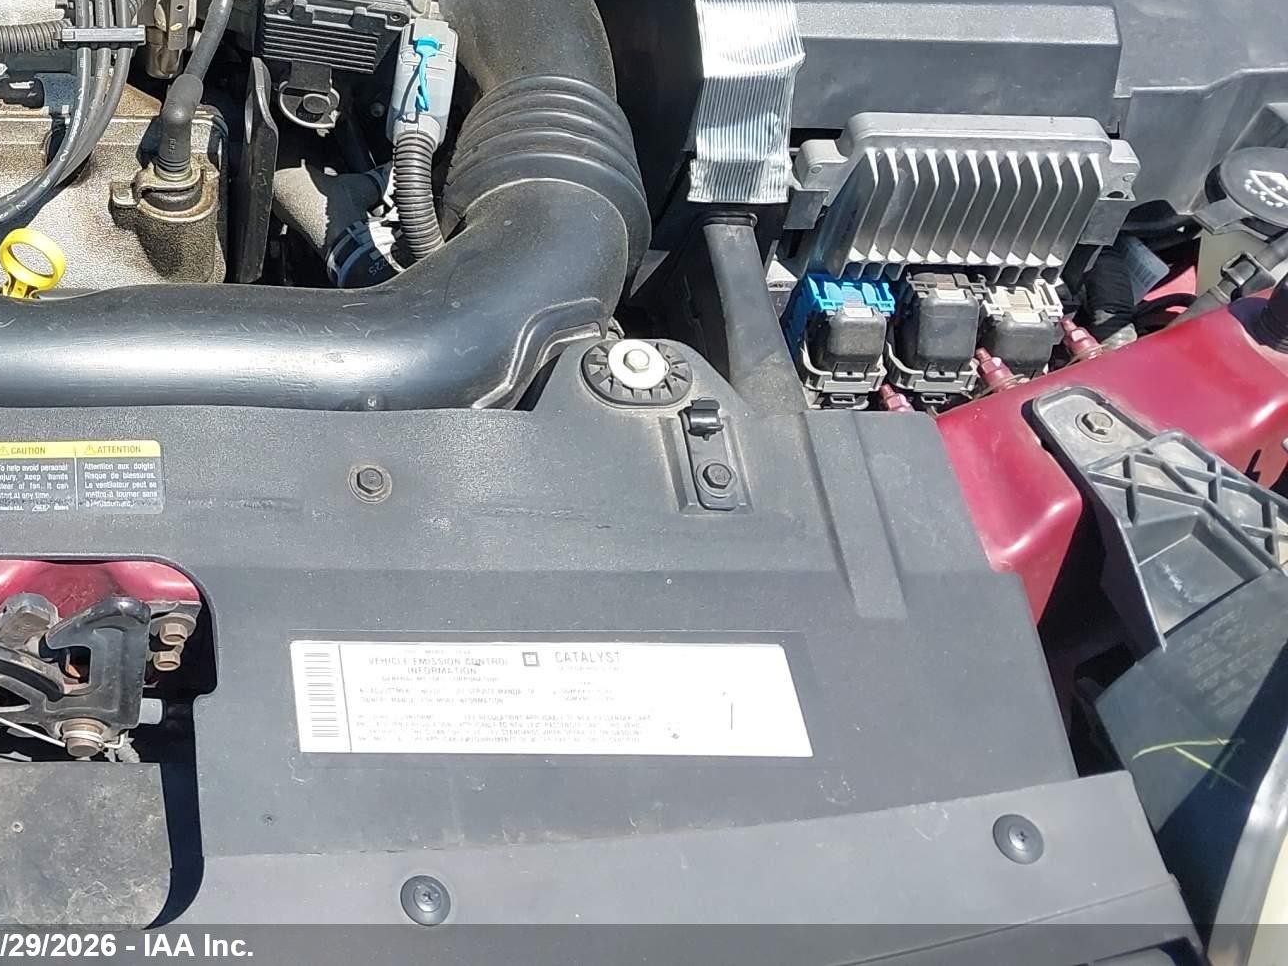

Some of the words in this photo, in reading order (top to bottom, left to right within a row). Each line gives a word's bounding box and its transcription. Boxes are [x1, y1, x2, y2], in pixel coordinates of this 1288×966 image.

[10, 446, 45, 454] CAUTION
[97, 445, 141, 453] ATTENTION
[23, 473, 41, 481] keep
[47, 473, 68, 481] hands
[84, 472, 106, 480] Risque
[110, 472, 119, 480] de
[413, 657, 461, 666] EMISSION
[554, 651, 621, 664] CATALYST
[407, 667, 478, 675] INFORMATION
